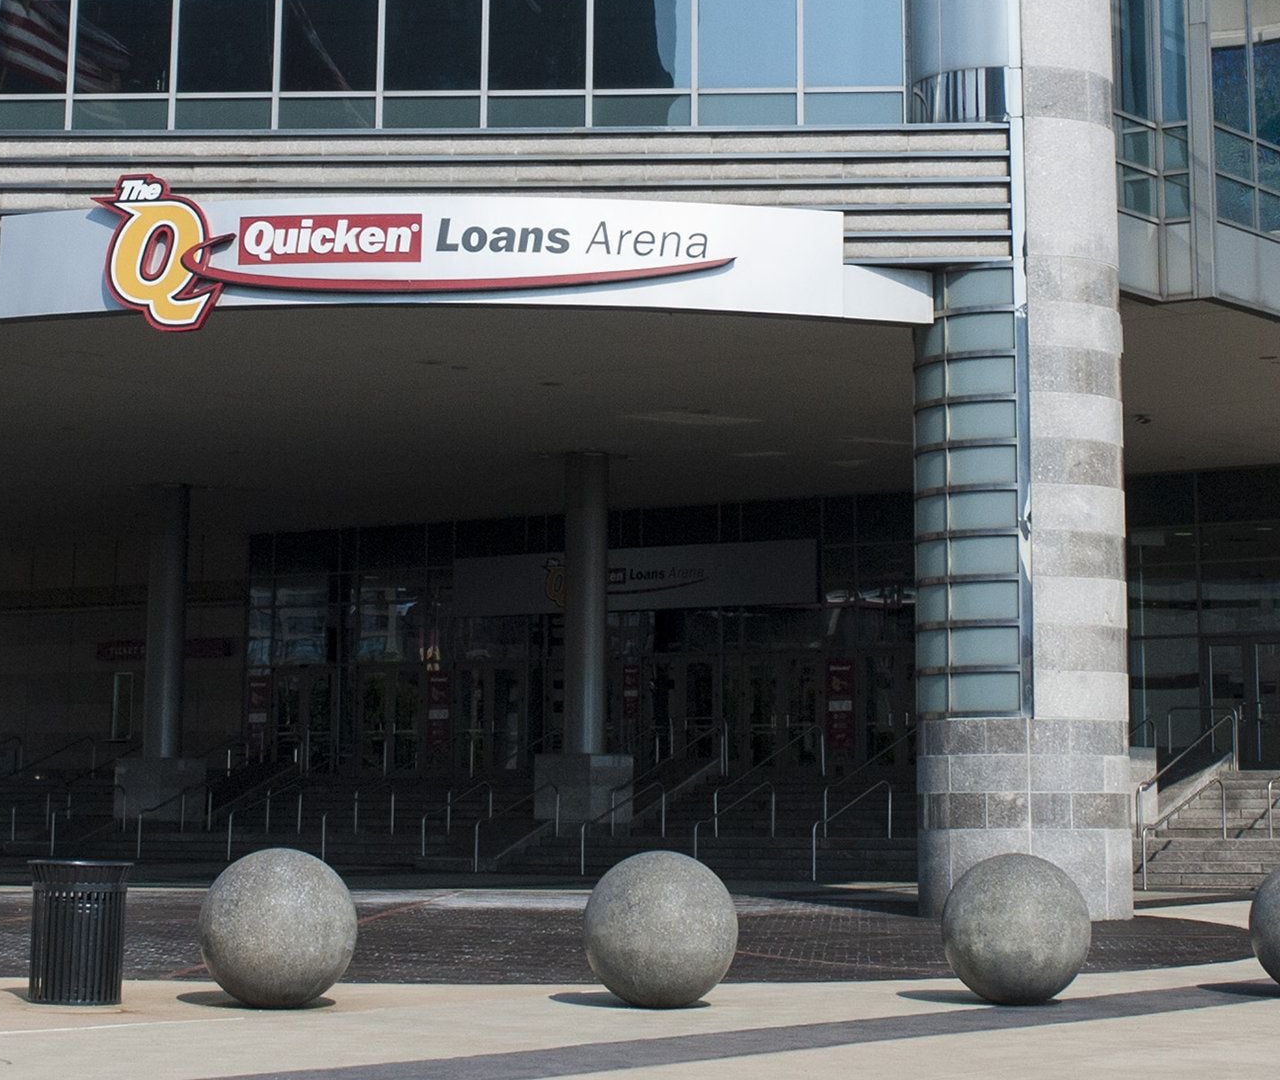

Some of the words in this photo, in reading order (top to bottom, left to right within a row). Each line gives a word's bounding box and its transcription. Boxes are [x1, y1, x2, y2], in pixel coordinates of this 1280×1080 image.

[119, 179, 162, 201] The
[243, 219, 413, 262] Quicken
[435, 218, 570, 254] Loans
[585, 221, 708, 259] Arena
[111, 200, 210, 326] Q
